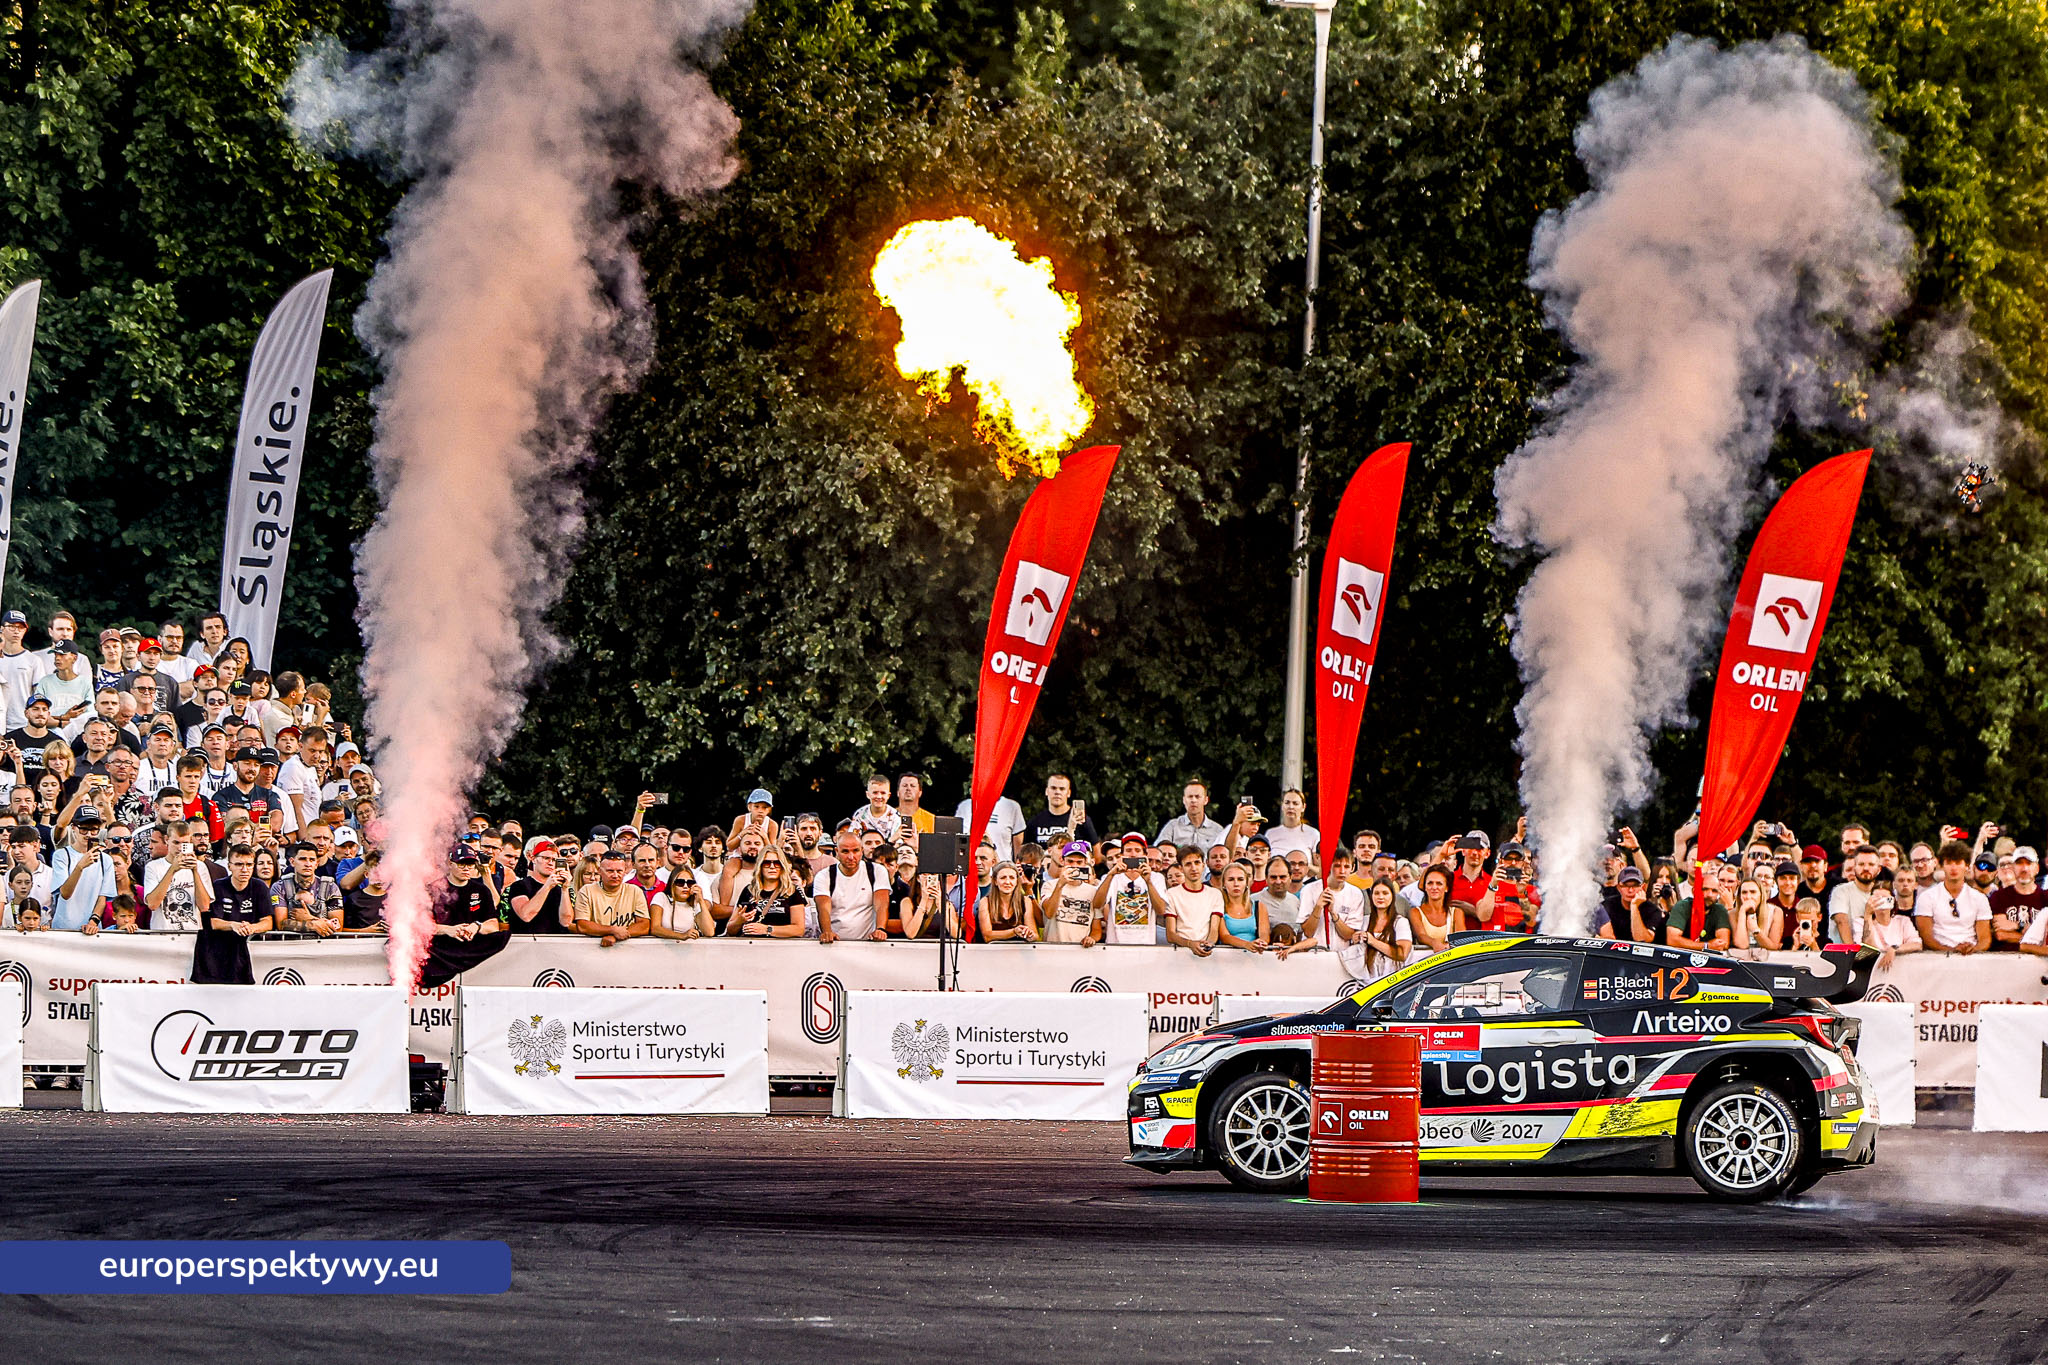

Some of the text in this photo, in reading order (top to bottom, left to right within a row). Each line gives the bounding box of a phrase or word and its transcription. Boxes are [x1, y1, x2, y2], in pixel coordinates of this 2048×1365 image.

[231, 386, 300, 608] Śląskie.
[1732, 662, 1807, 692] ORLEN
[1333, 680, 1354, 702] OIL
[1750, 693, 1779, 713] OIL
[1599, 976, 1652, 989] R.Blach
[1651, 968, 1690, 1001] 12
[1599, 989, 1651, 1001] D.Sosa
[573, 1021, 687, 1037] Ministerstwo
[1632, 1008, 1731, 1034] Arteixo
[198, 1030, 358, 1054] MOTO
[956, 1026, 1069, 1043] Ministerstwo
[1433, 1031, 1464, 1039] ORLEN
[572, 1043, 725, 1063] Sportu i Turystyki
[955, 1050, 1106, 1069] Sportu i Turystyki
[194, 1062, 344, 1079] WIZJA
[1349, 1109, 1389, 1120] ORLEN
[1349, 1122, 1364, 1130] OIL
[1502, 1124, 1544, 1139] 2027
